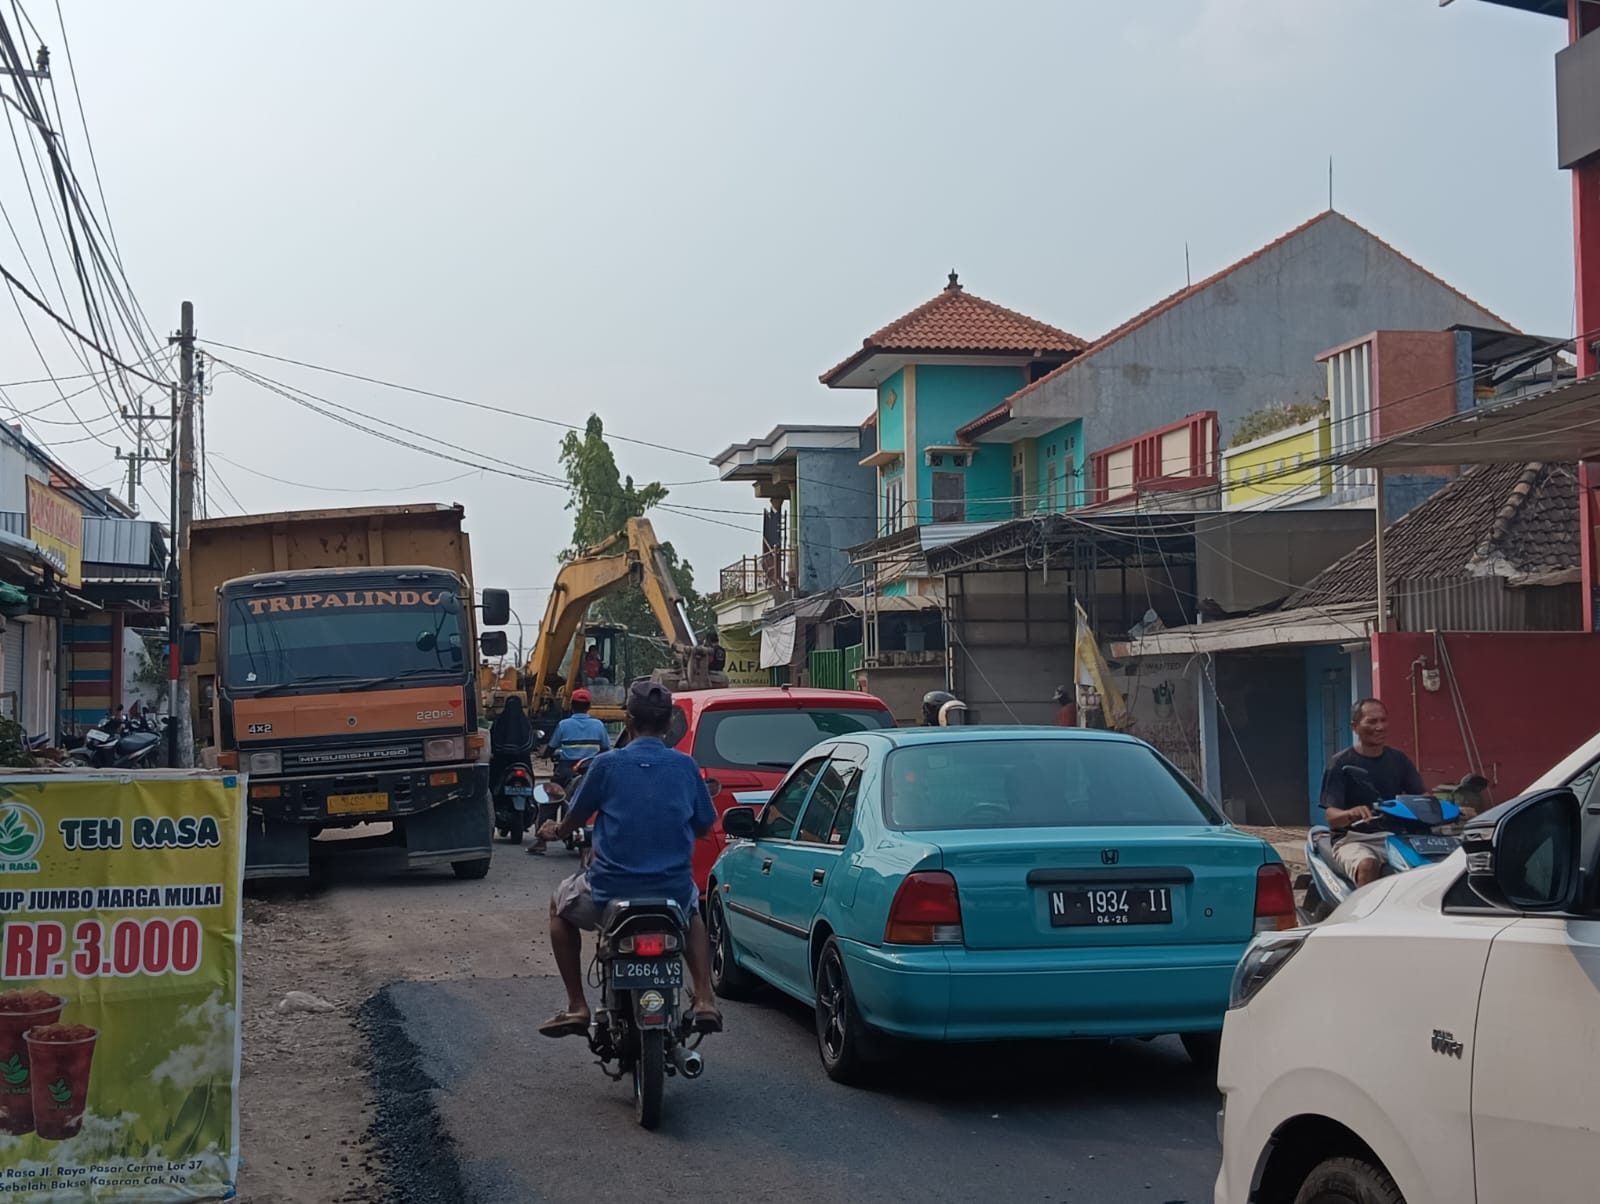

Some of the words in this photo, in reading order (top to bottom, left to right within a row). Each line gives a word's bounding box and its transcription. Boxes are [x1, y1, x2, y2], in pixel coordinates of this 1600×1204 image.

[300, 752, 370, 762] MITSUBISHI
[373, 749, 407, 757] FUSO
[60, 819, 121, 847] TEH
[133, 817, 219, 846] RASA
[9, 862, 38, 871] RASA
[28, 889, 93, 910] JUMBO
[97, 887, 161, 908] HARGA
[164, 886, 222, 907] MULAI
[1052, 892, 1065, 915] N
[1087, 889, 1129, 914] 1934
[1149, 888, 1168, 912] II
[615, 964, 625, 977] L
[627, 963, 659, 977] 2664
[665, 962, 681, 976] VS
[7, 1168, 36, 1179] Rasa
[40, 1167, 52, 1177] Jl.
[57, 1166, 86, 1178] Raya
[90, 1164, 123, 1174] Pasar
[127, 1163, 164, 1173] Cerme
[167, 1162, 186, 1171] Lor
[188, 1160, 203, 1170] 37
[51, 1179, 87, 1190] Bakso
[90, 1175, 140, 1187] Kasaran
[144, 1176, 165, 1186] Cak
[170, 1174, 186, 1184] No
